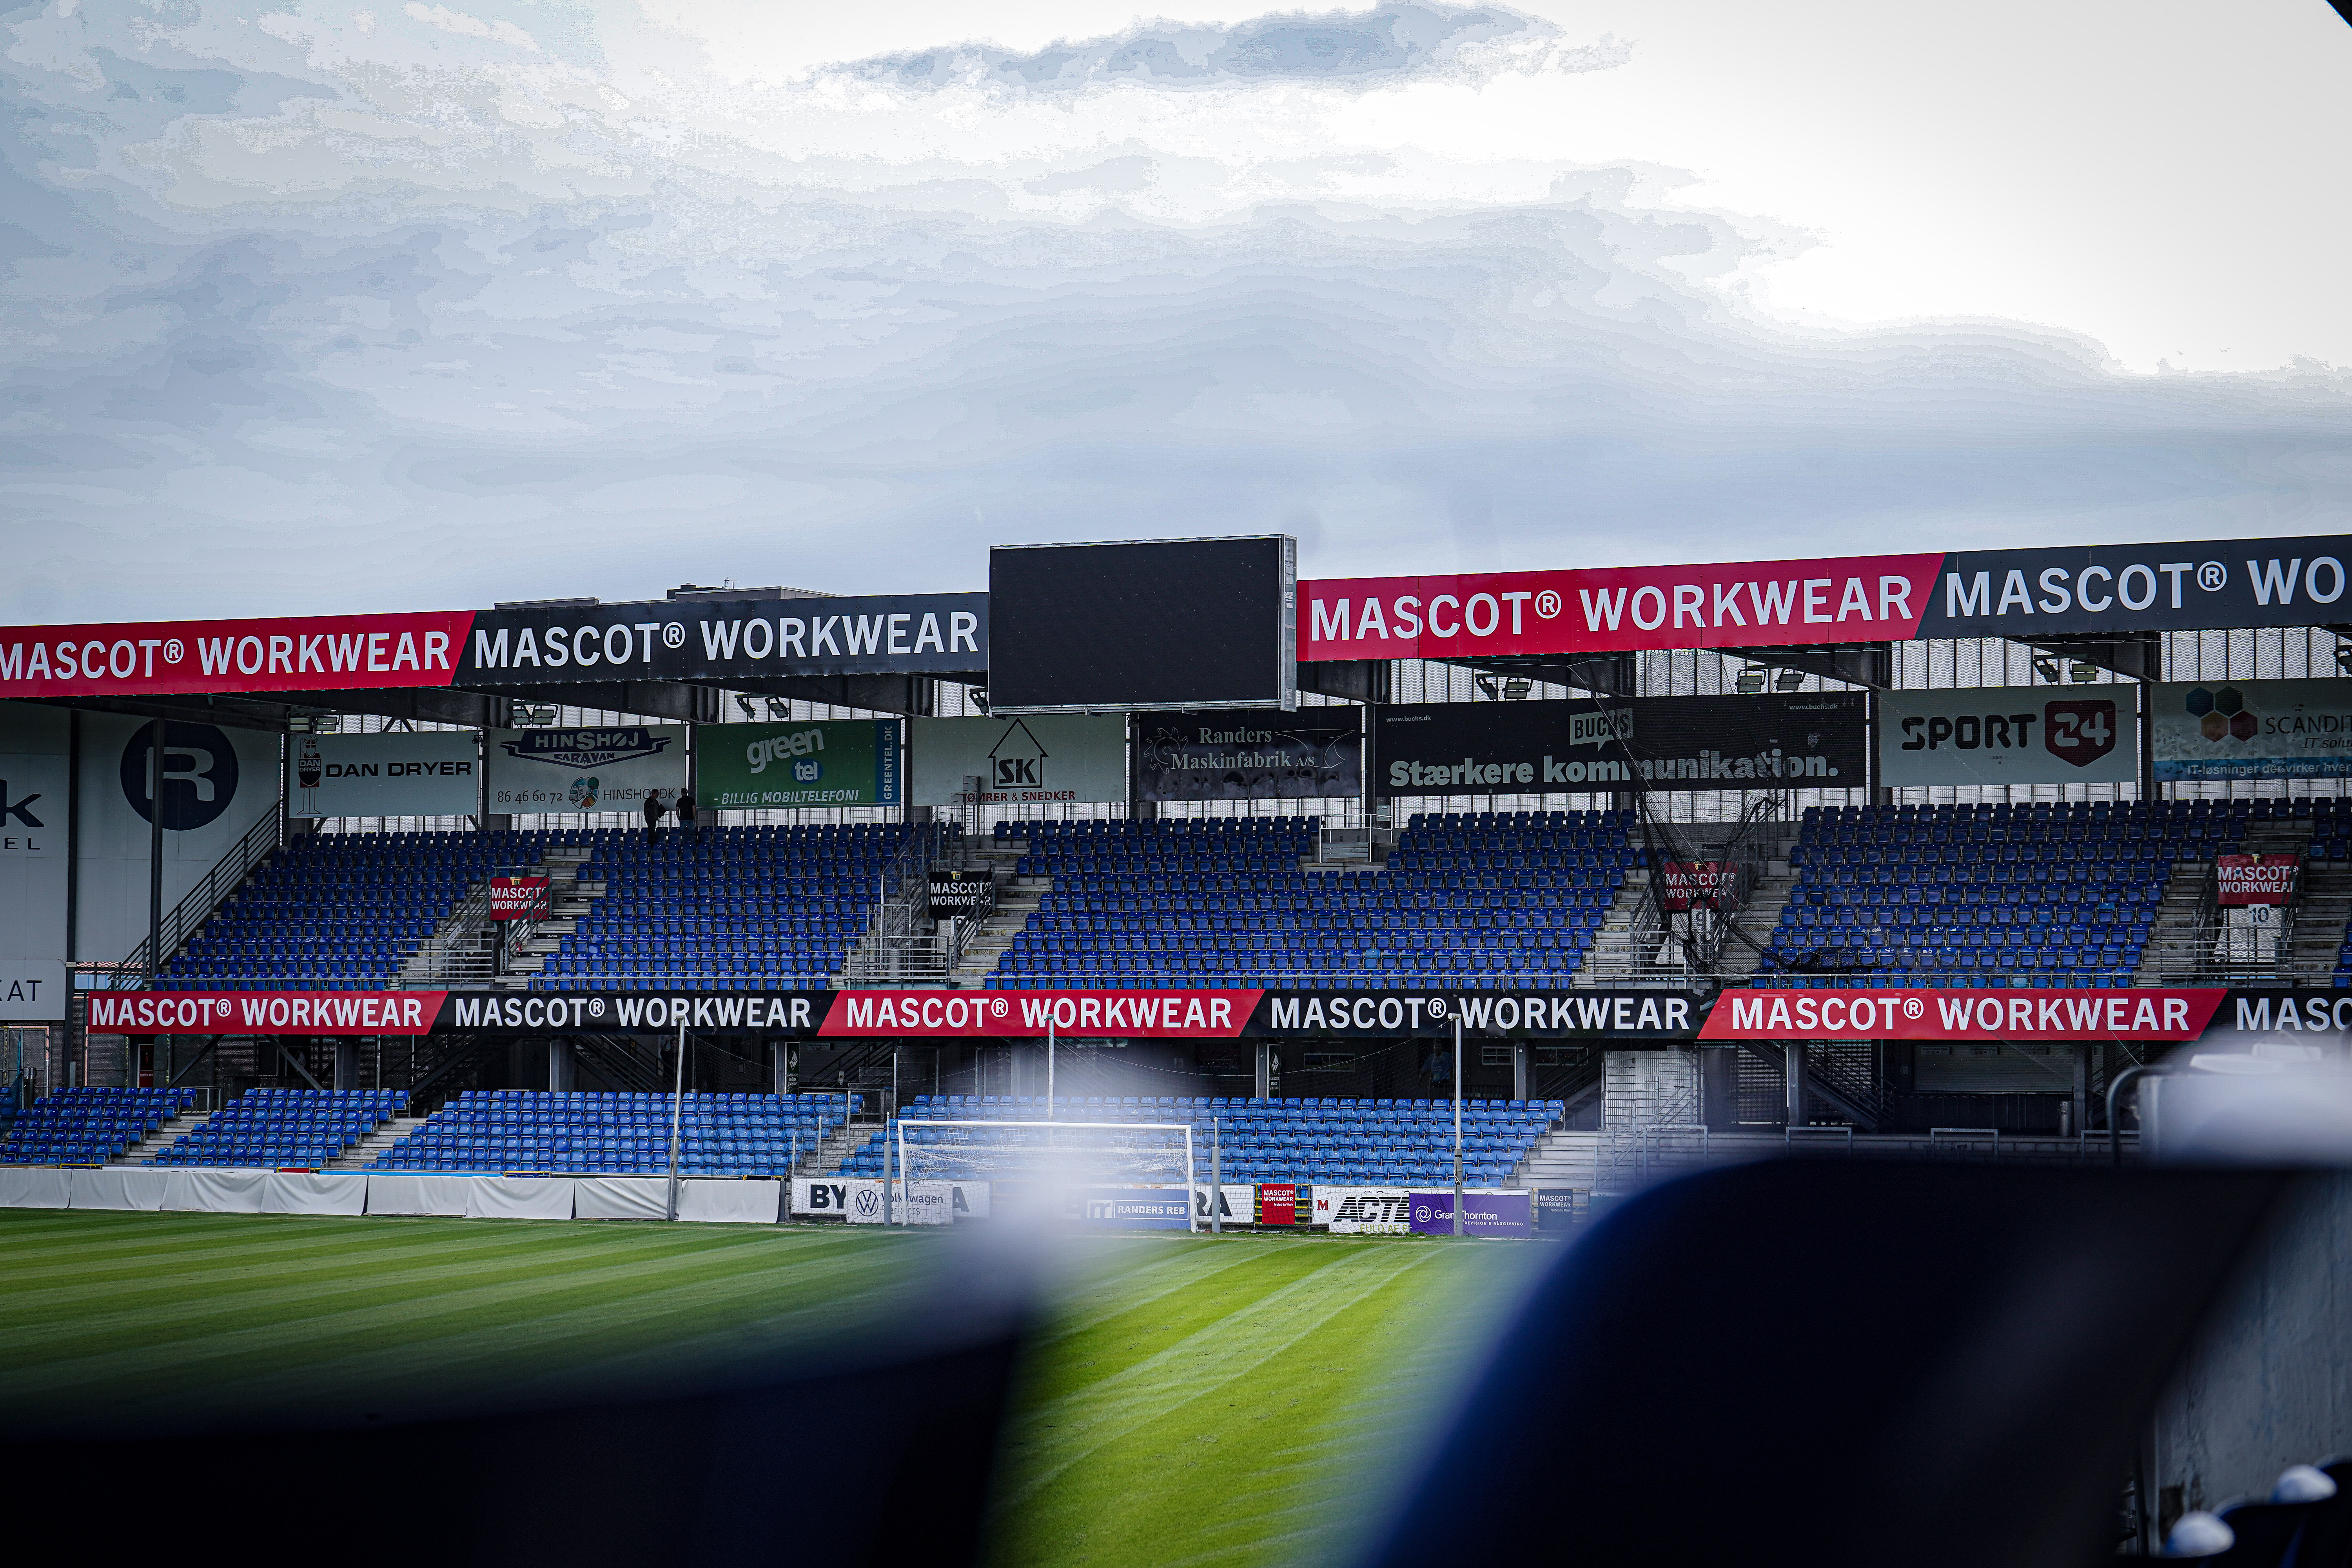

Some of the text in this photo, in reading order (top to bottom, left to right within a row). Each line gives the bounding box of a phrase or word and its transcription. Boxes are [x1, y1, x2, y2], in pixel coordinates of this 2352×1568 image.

[1947, 556, 2345, 617] MASCOT® WO
[1312, 575, 1913, 641] MASCOT® WORKWEAR
[475, 612, 978, 668] MASCOT® WORKWEAR
[0, 631, 450, 680] MASCOT® WORKWEAR
[1199, 727, 1272, 744] Randers
[1574, 714, 1629, 739] BUCHS
[1902, 712, 2111, 750] SPORT 24
[535, 731, 639, 750] HINSHØJ
[2303, 738, 2319, 748] IT
[554, 752, 615, 764] CARAVAN
[746, 728, 824, 773] green
[1171, 751, 1314, 769] Maskinfabrik A/S
[326, 761, 471, 777] DAN DRYER
[795, 761, 818, 780] tel
[999, 759, 1037, 784] SK
[1390, 749, 1838, 787] Stærkere kommunikation.
[2187, 764, 2259, 776] IT-løsninger
[2285, 762, 2320, 773] virker
[497, 790, 563, 804] 86 46 60 72
[604, 788, 675, 800] HINSHODK
[722, 791, 758, 804] BILLIG
[762, 790, 859, 803] MOBILTELEFONI
[1022, 791, 1076, 801] SNEDKER
[1666, 888, 1727, 898] WORKWEA
[2249, 907, 2269, 923] 10
[0, 980, 42, 1001] AT
[93, 998, 421, 1026] MASCOT® WORKWEAR
[455, 998, 810, 1027] MASCOT® WORKWEAR
[847, 998, 1232, 1028] MASCOT® WORKWEAR
[1271, 998, 1689, 1029] MASCOT® WORKWEAR
[1733, 998, 2190, 1031] MASCOT® WORKWEAR
[1118, 1205, 1185, 1215] RANDERS REB
[1434, 1210, 1497, 1220] Gran hornton
